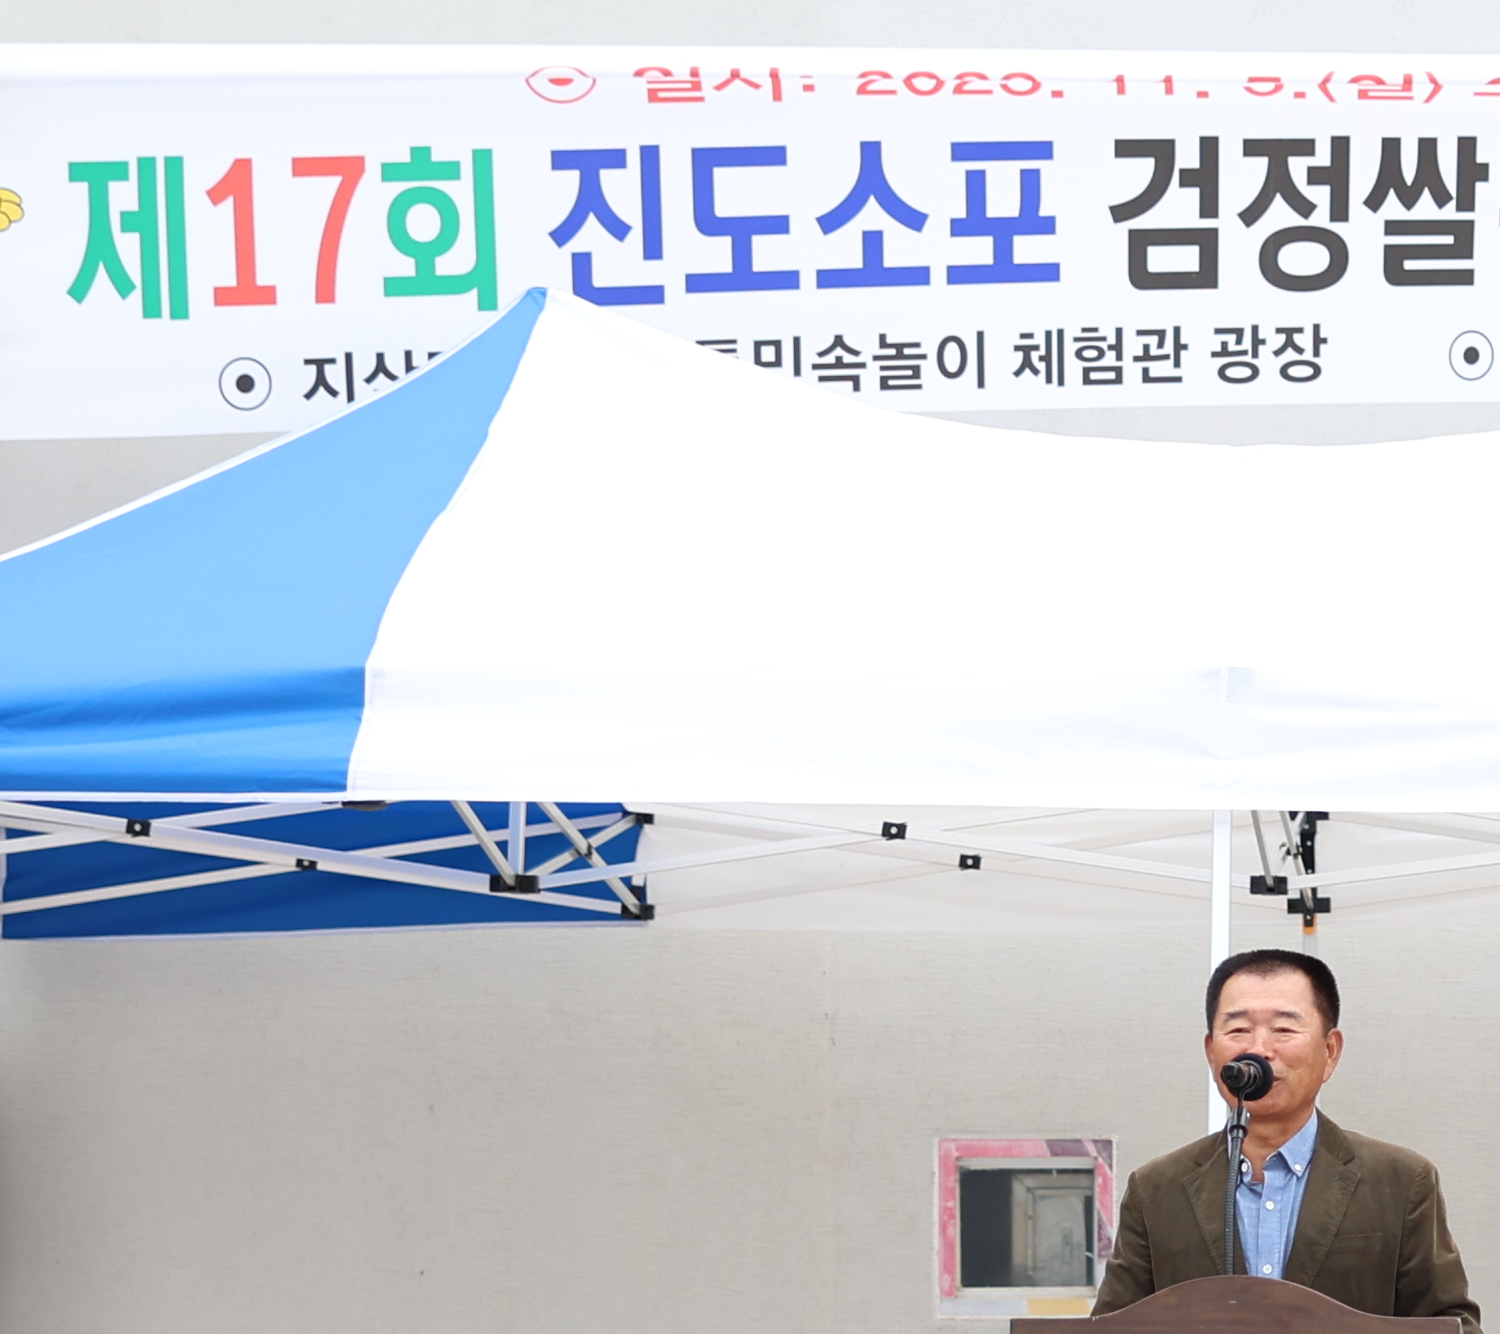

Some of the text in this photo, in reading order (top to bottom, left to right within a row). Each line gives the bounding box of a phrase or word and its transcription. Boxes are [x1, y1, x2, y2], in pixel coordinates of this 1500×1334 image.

[66, 145, 500, 321] 제17회
[547, 140, 1062, 306] 진도소포
[1012, 325, 1190, 388] 체험관
[1210, 322, 1329, 385] 광장
